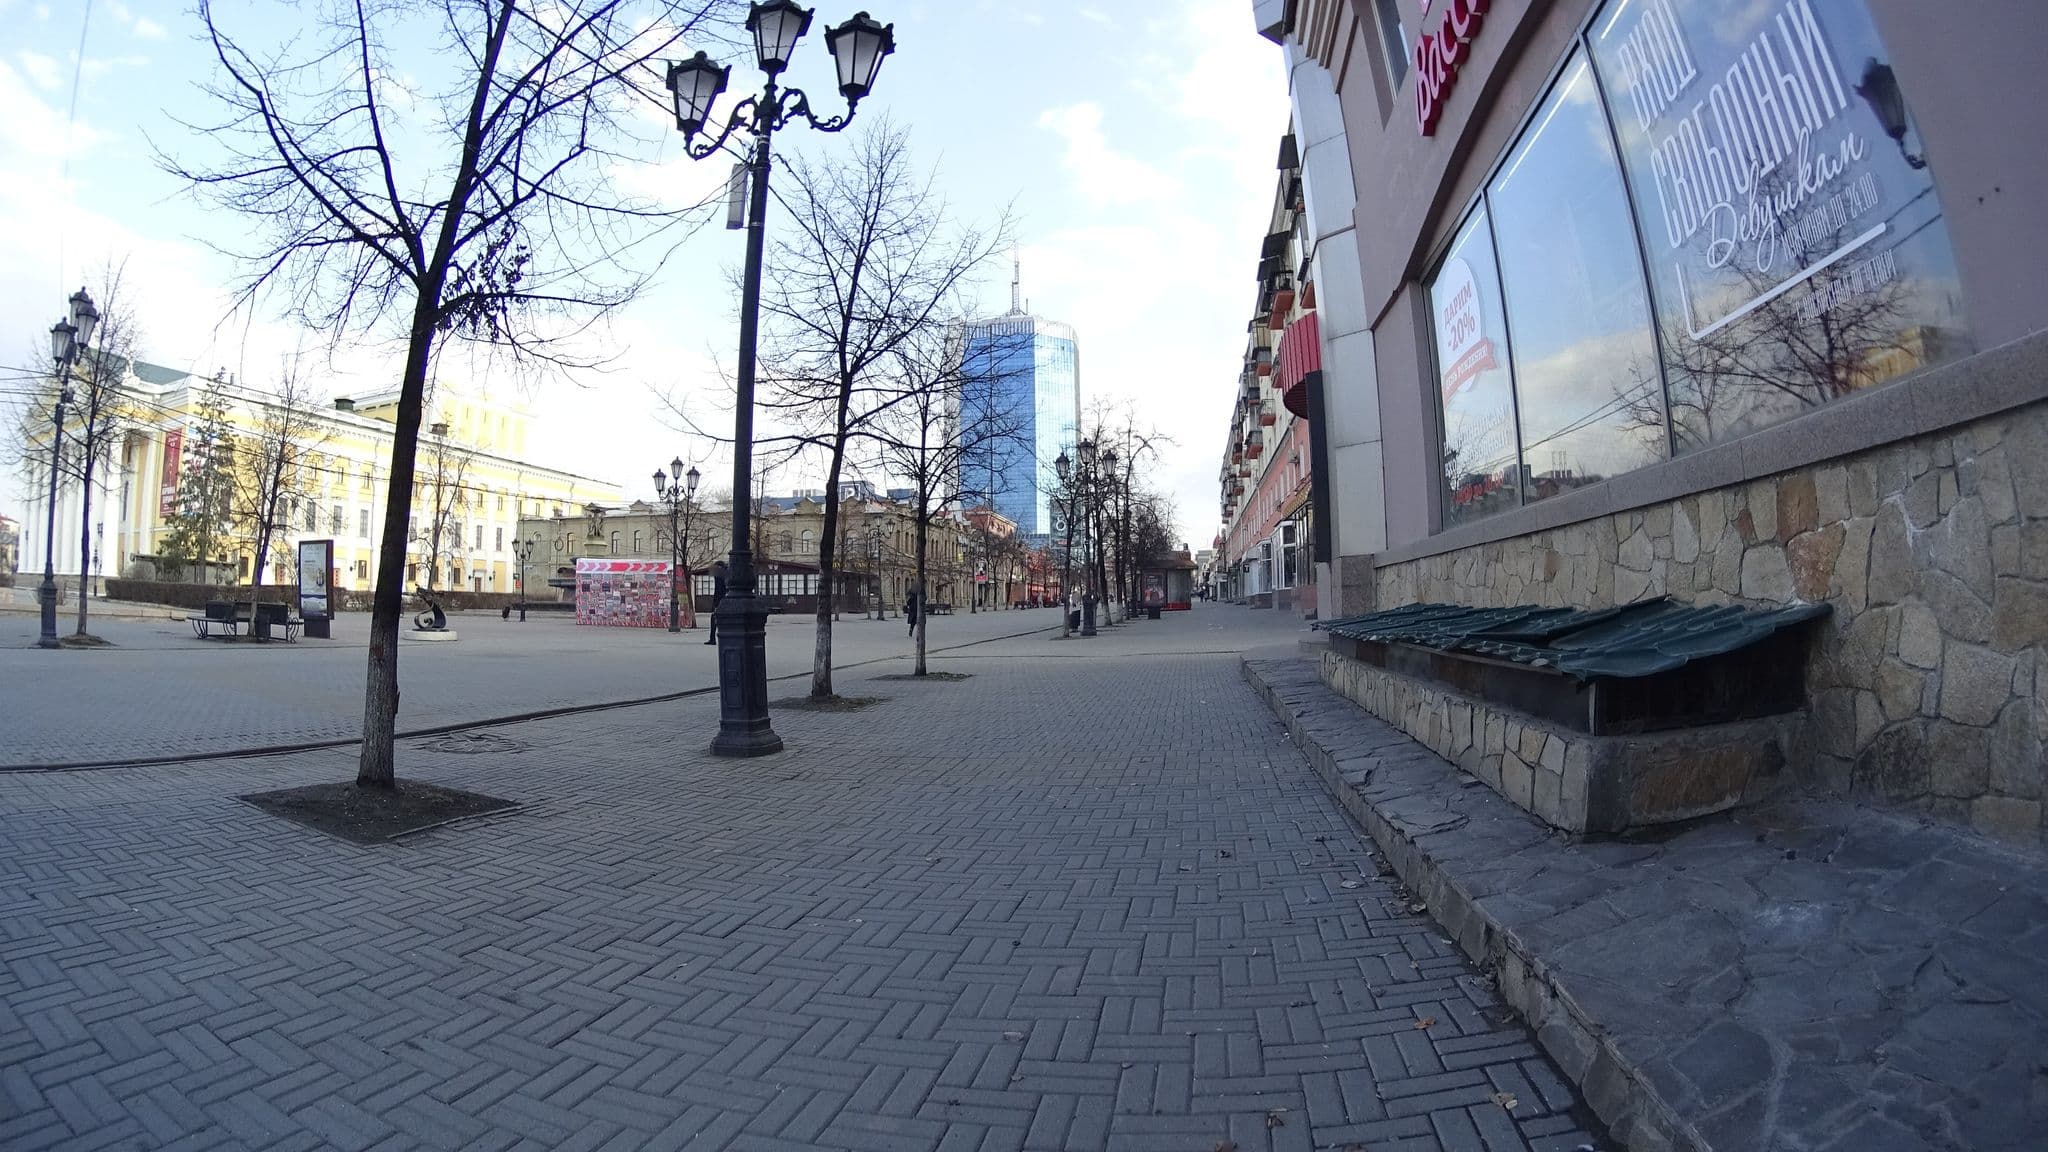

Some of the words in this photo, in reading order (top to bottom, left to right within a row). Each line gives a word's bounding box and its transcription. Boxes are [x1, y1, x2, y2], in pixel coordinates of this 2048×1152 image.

[1414, 0, 1484, 136] Васс
[1618, 0, 1697, 133] ВХОД
[1702, 126, 1864, 274] Девушкам
[1780, 204, 1832, 261] МУЖЧИНАМ
[1830, 194, 1848, 229] ДО
[1845, 172, 1879, 219] 24.00
[1443, 279, 1472, 329] ДАРИМ
[1447, 306, 1476, 351] -20%
